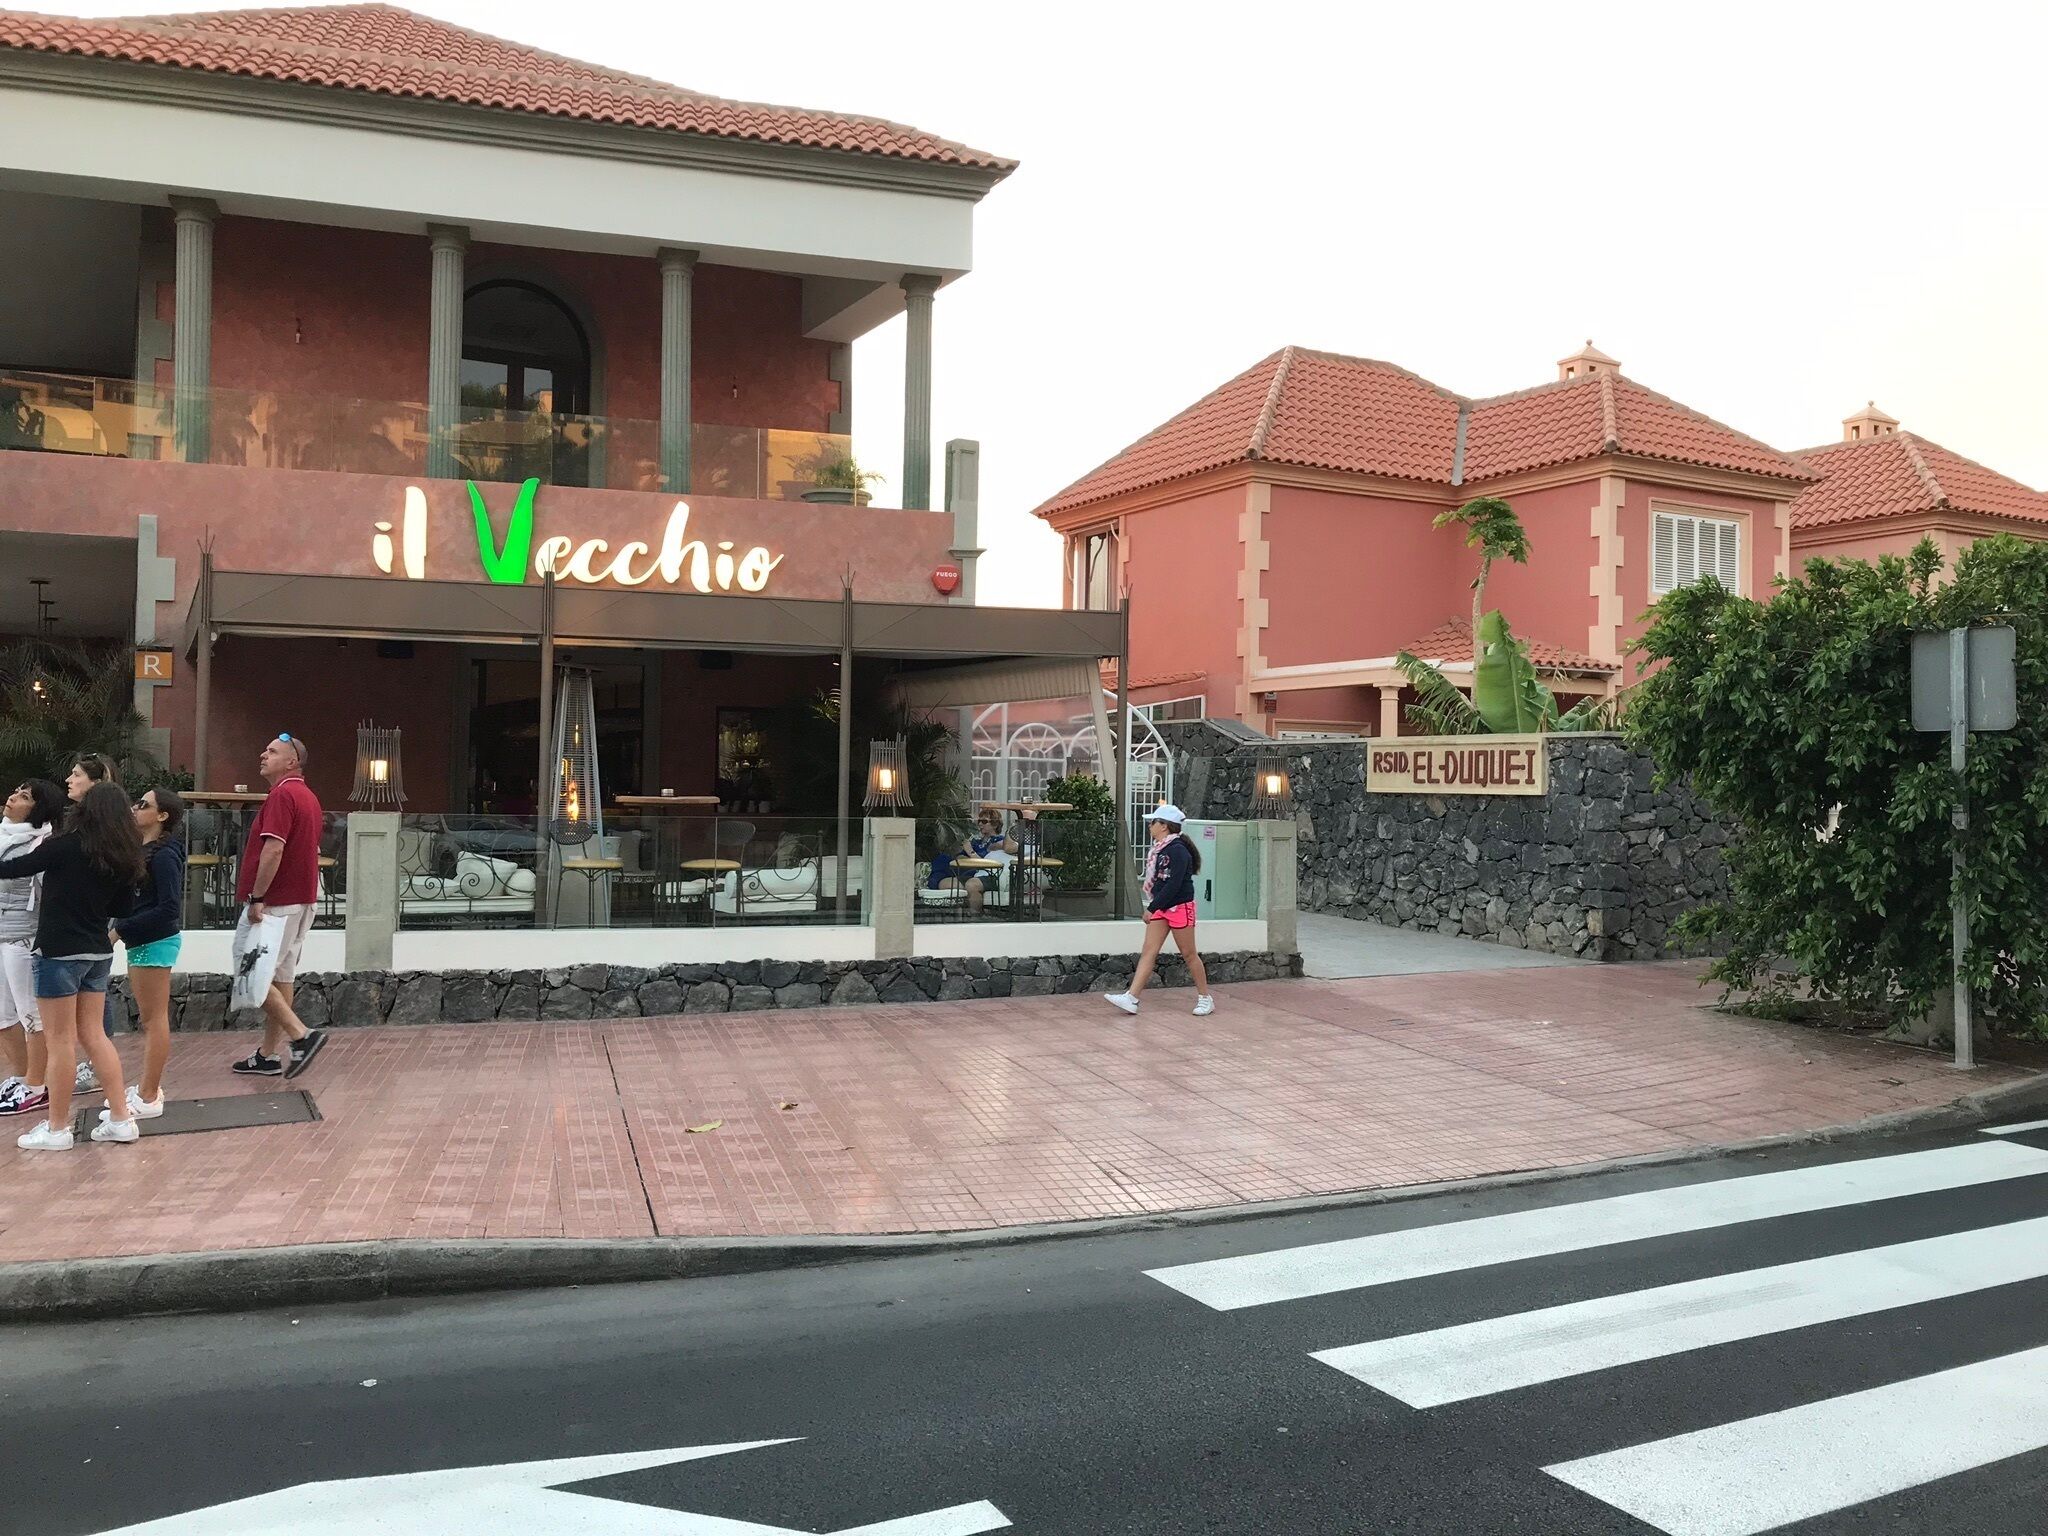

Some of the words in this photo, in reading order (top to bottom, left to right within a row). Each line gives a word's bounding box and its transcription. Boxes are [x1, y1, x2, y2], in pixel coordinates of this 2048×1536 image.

[373, 486, 427, 579] il
[467, 478, 785, 593] Vecchio
[144, 654, 162, 676] R
[1373, 751, 1411, 774] RSID.
